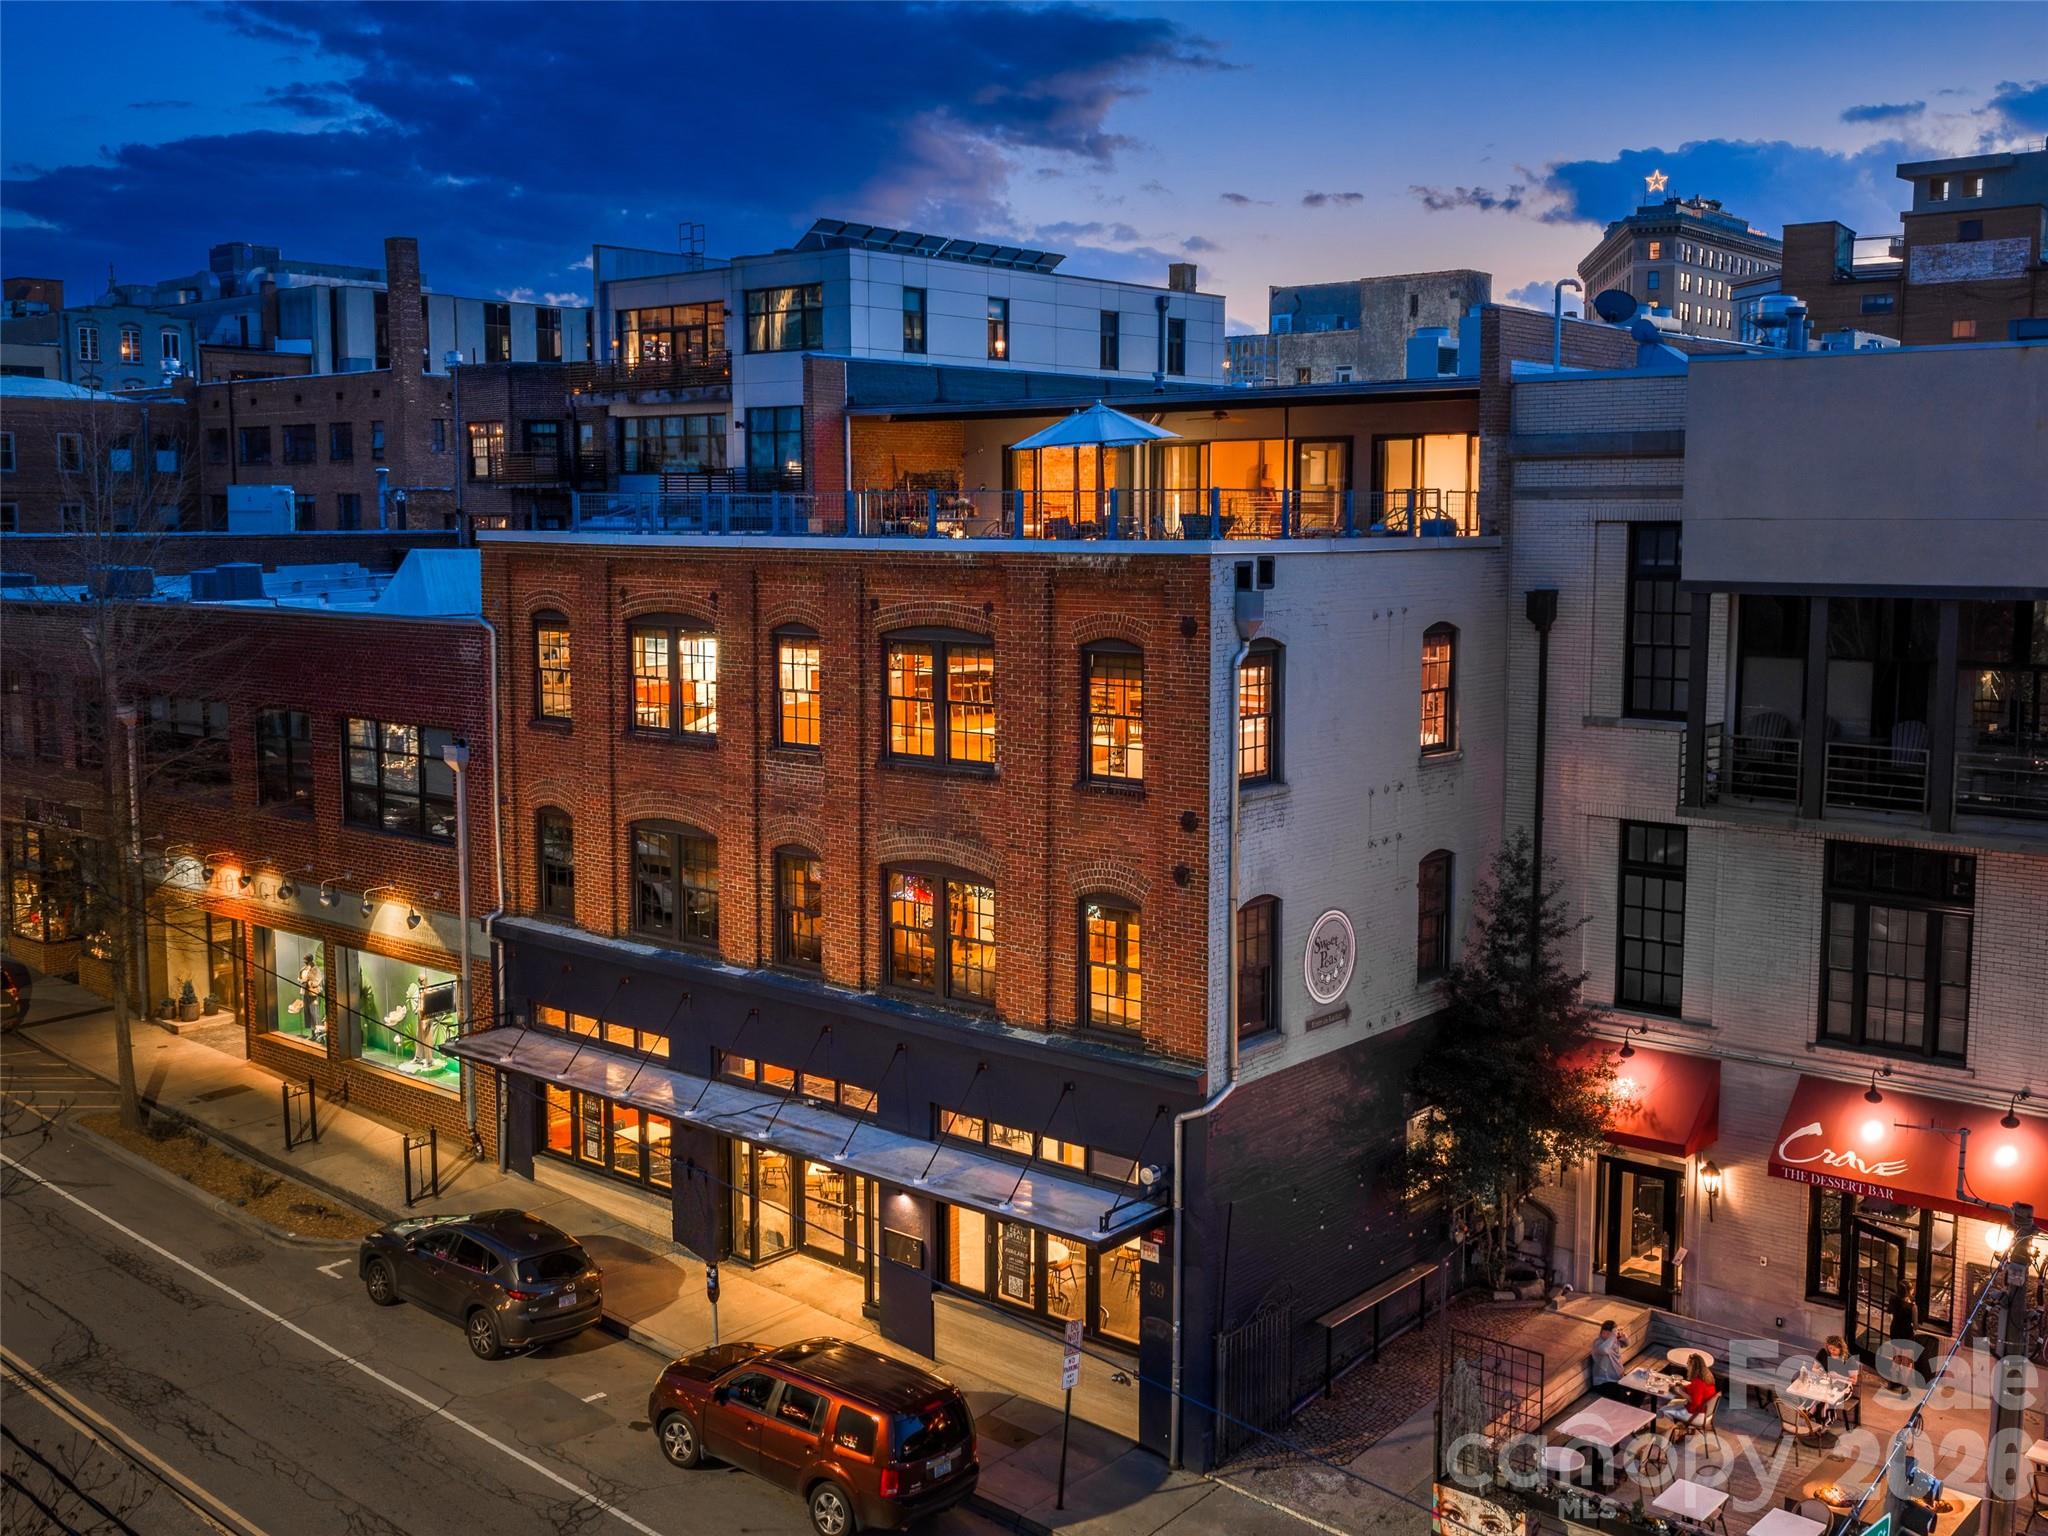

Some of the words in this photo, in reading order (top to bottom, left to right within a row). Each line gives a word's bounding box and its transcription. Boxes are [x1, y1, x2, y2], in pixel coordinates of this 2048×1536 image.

[1314, 935, 1339, 954] Sweet
[1320, 950, 1338, 969] Peas
[1781, 1166, 1808, 1182] THE
[1811, 1172, 1866, 1195] DESSERT
[1867, 1183, 1894, 1201] BAR
[1004, 1247, 1029, 1260] AVAILABLE
[1149, 1280, 1165, 1299] 39
[1067, 1331, 1080, 1342] NOT
